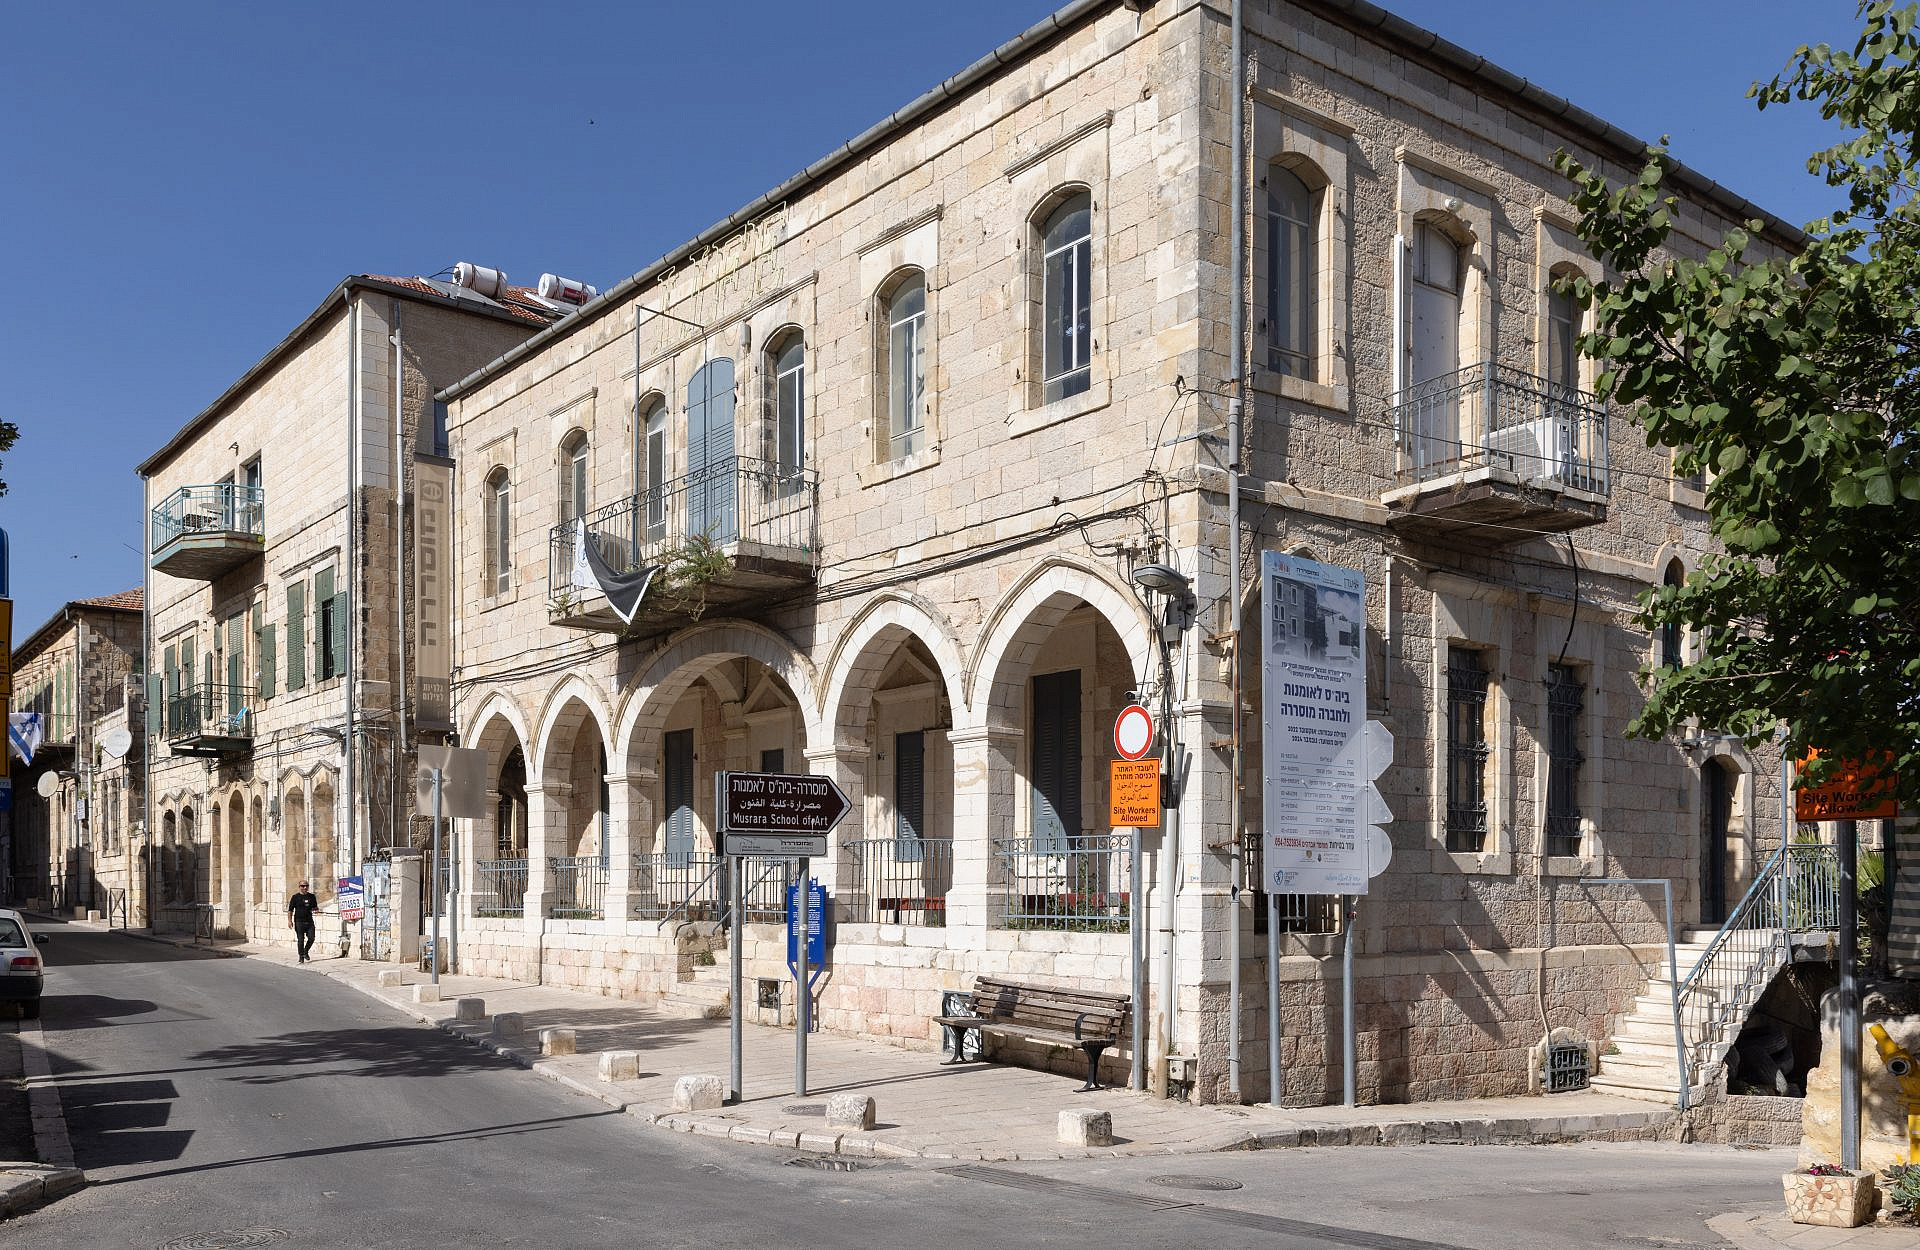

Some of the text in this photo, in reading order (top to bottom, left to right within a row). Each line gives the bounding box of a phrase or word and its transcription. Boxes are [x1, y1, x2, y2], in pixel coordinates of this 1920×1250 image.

[1283, 683, 1322, 700] לאומנות
[1280, 703, 1350, 723] ולחברה מוסררה
[1134, 772, 1156, 780] הכניסה
[733, 778, 765, 793] לאמנות
[1802, 793, 1828, 805] Site
[1127, 806, 1156, 814] Workers
[732, 812, 828, 826] Musrara School of Art
[1120, 814, 1148, 822] Allowed
